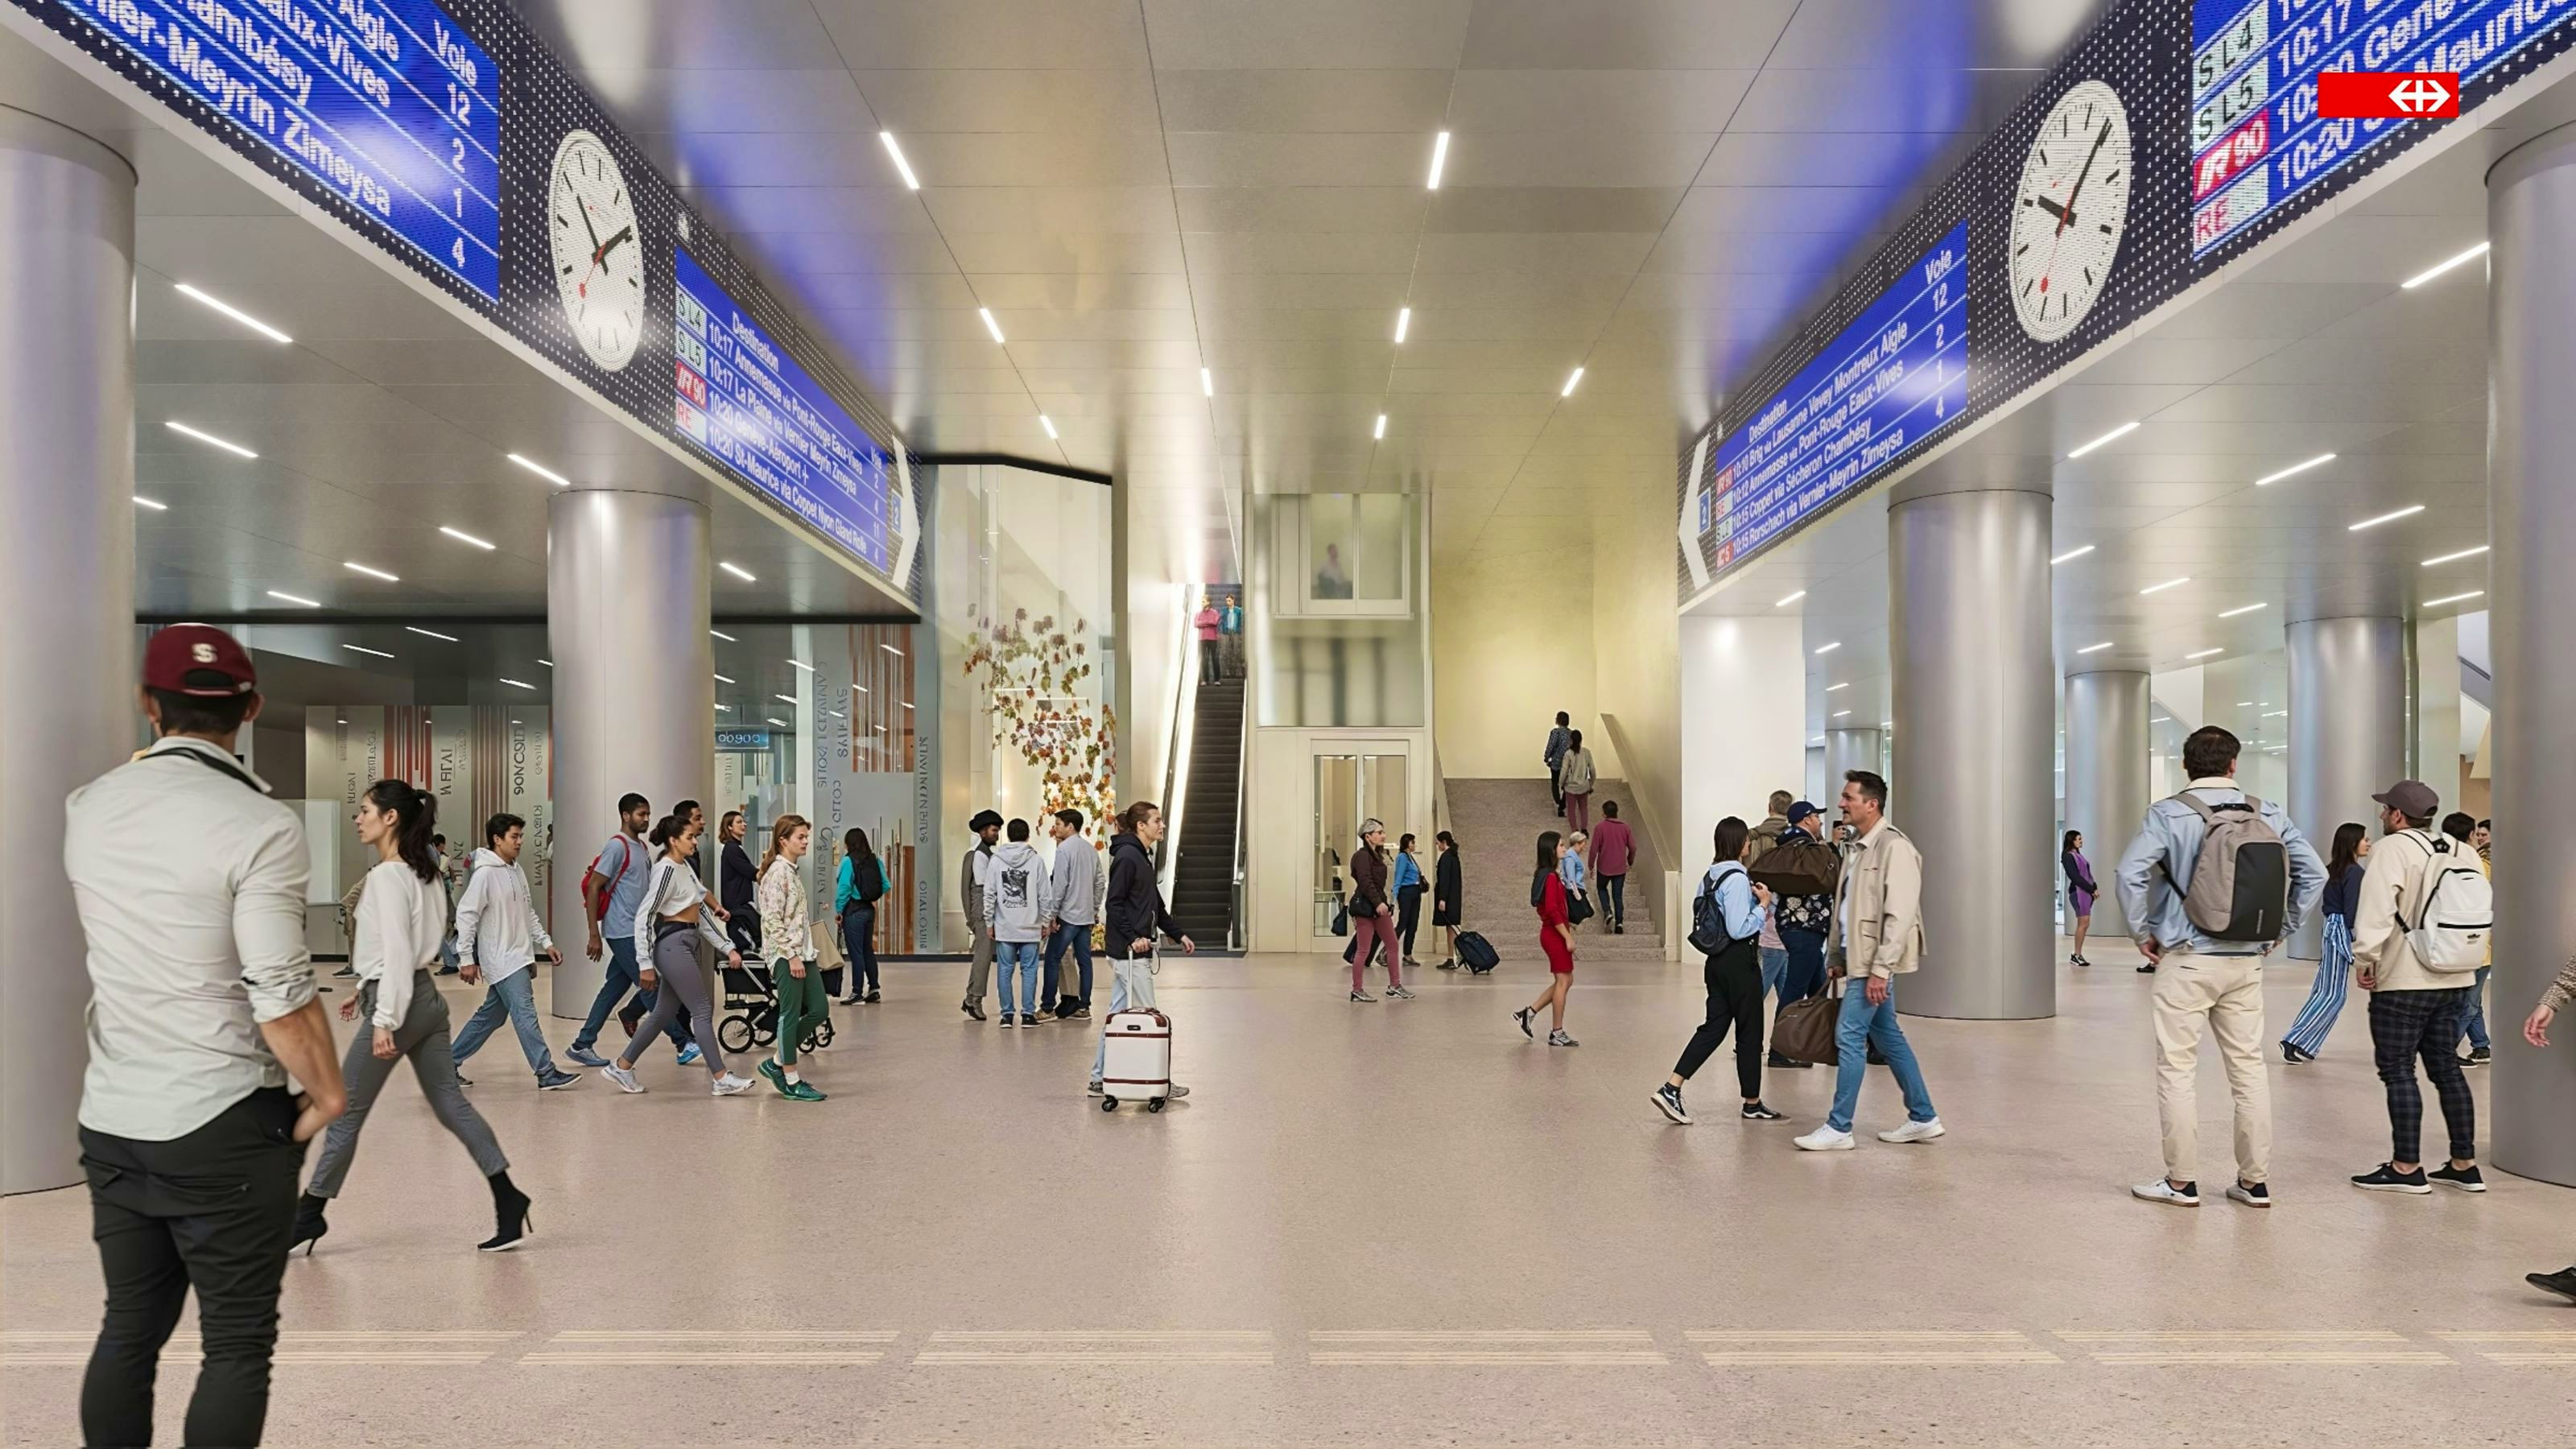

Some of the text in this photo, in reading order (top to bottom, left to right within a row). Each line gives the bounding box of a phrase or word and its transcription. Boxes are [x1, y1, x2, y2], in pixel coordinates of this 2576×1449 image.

[179, 0, 462, 218] ambésy 1
[434, 19, 477, 87] Voie
[448, 82, 471, 127] 12
[283, 107, 391, 217] Zimeysa
[452, 237, 465, 268] 4
[452, 137, 465, 173] 2
[2197, 197, 2229, 245] RE
[2278, 118, 2355, 190] 10:20
[2234, 119, 2264, 167] 90
[693, 377, 706, 407] 90
[709, 390, 733, 426] 10:20
[709, 321, 733, 359] 10:17
[734, 345, 782, 403] Annemasse
[792, 396, 831, 448] Pont-Rouge
[831, 432, 862, 476] Eaux-Vives
[874, 473, 880, 490] 2
[733, 311, 882, 470] Destination Voie
[1716, 499, 1725, 521] RE
[1748, 452, 1789, 493] Annemasse
[1798, 405, 1848, 456] Pont-Rouge
[1848, 360, 1904, 416] Eaux-Vives
[1936, 324, 1944, 350] 2
[1749, 250, 1952, 444] Destination Voie
[1749, 444, 1763, 468] Brig
[1773, 407, 1808, 448] Lausanne
[1808, 385, 1833, 417] Vevey
[1834, 345, 1880, 397] Montreux
[1880, 320, 1908, 358] Aigle
[1933, 282, 1948, 313] 12
[678, 402, 692, 430] RE
[709, 424, 733, 460] 10:20
[734, 443, 780, 493] St-Maurice
[780, 479, 791, 502] via
[792, 485, 818, 519] Coppet
[818, 504, 835, 532] Nyon
[835, 518, 853, 545] Gland
[709, 355, 733, 393] 10:17
[735, 376, 746, 405] La
[747, 387, 772, 427] Plaine
[774, 415, 783, 436] via
[832, 460, 857, 497] Zimeysa
[1724, 545, 1731, 563] 5
[1732, 530, 1749, 556] 10:15
[1749, 507, 1785, 546] Rorschach
[1786, 500, 1798, 521] via
[1798, 457, 1859, 512] Vernier-Meyrin
[1860, 428, 1904, 472] Zimeysa
[1935, 395, 1945, 419] 4
[1732, 505, 1749, 531] 10:15
[1749, 487, 1774, 519] Coppet
[1773, 481, 1785, 501] via
[1785, 453, 1823, 493] Sécheron
[1823, 417, 1872, 464] Chambésy
[1936, 359, 1942, 382] 1
[192, 643, 218, 663] S
